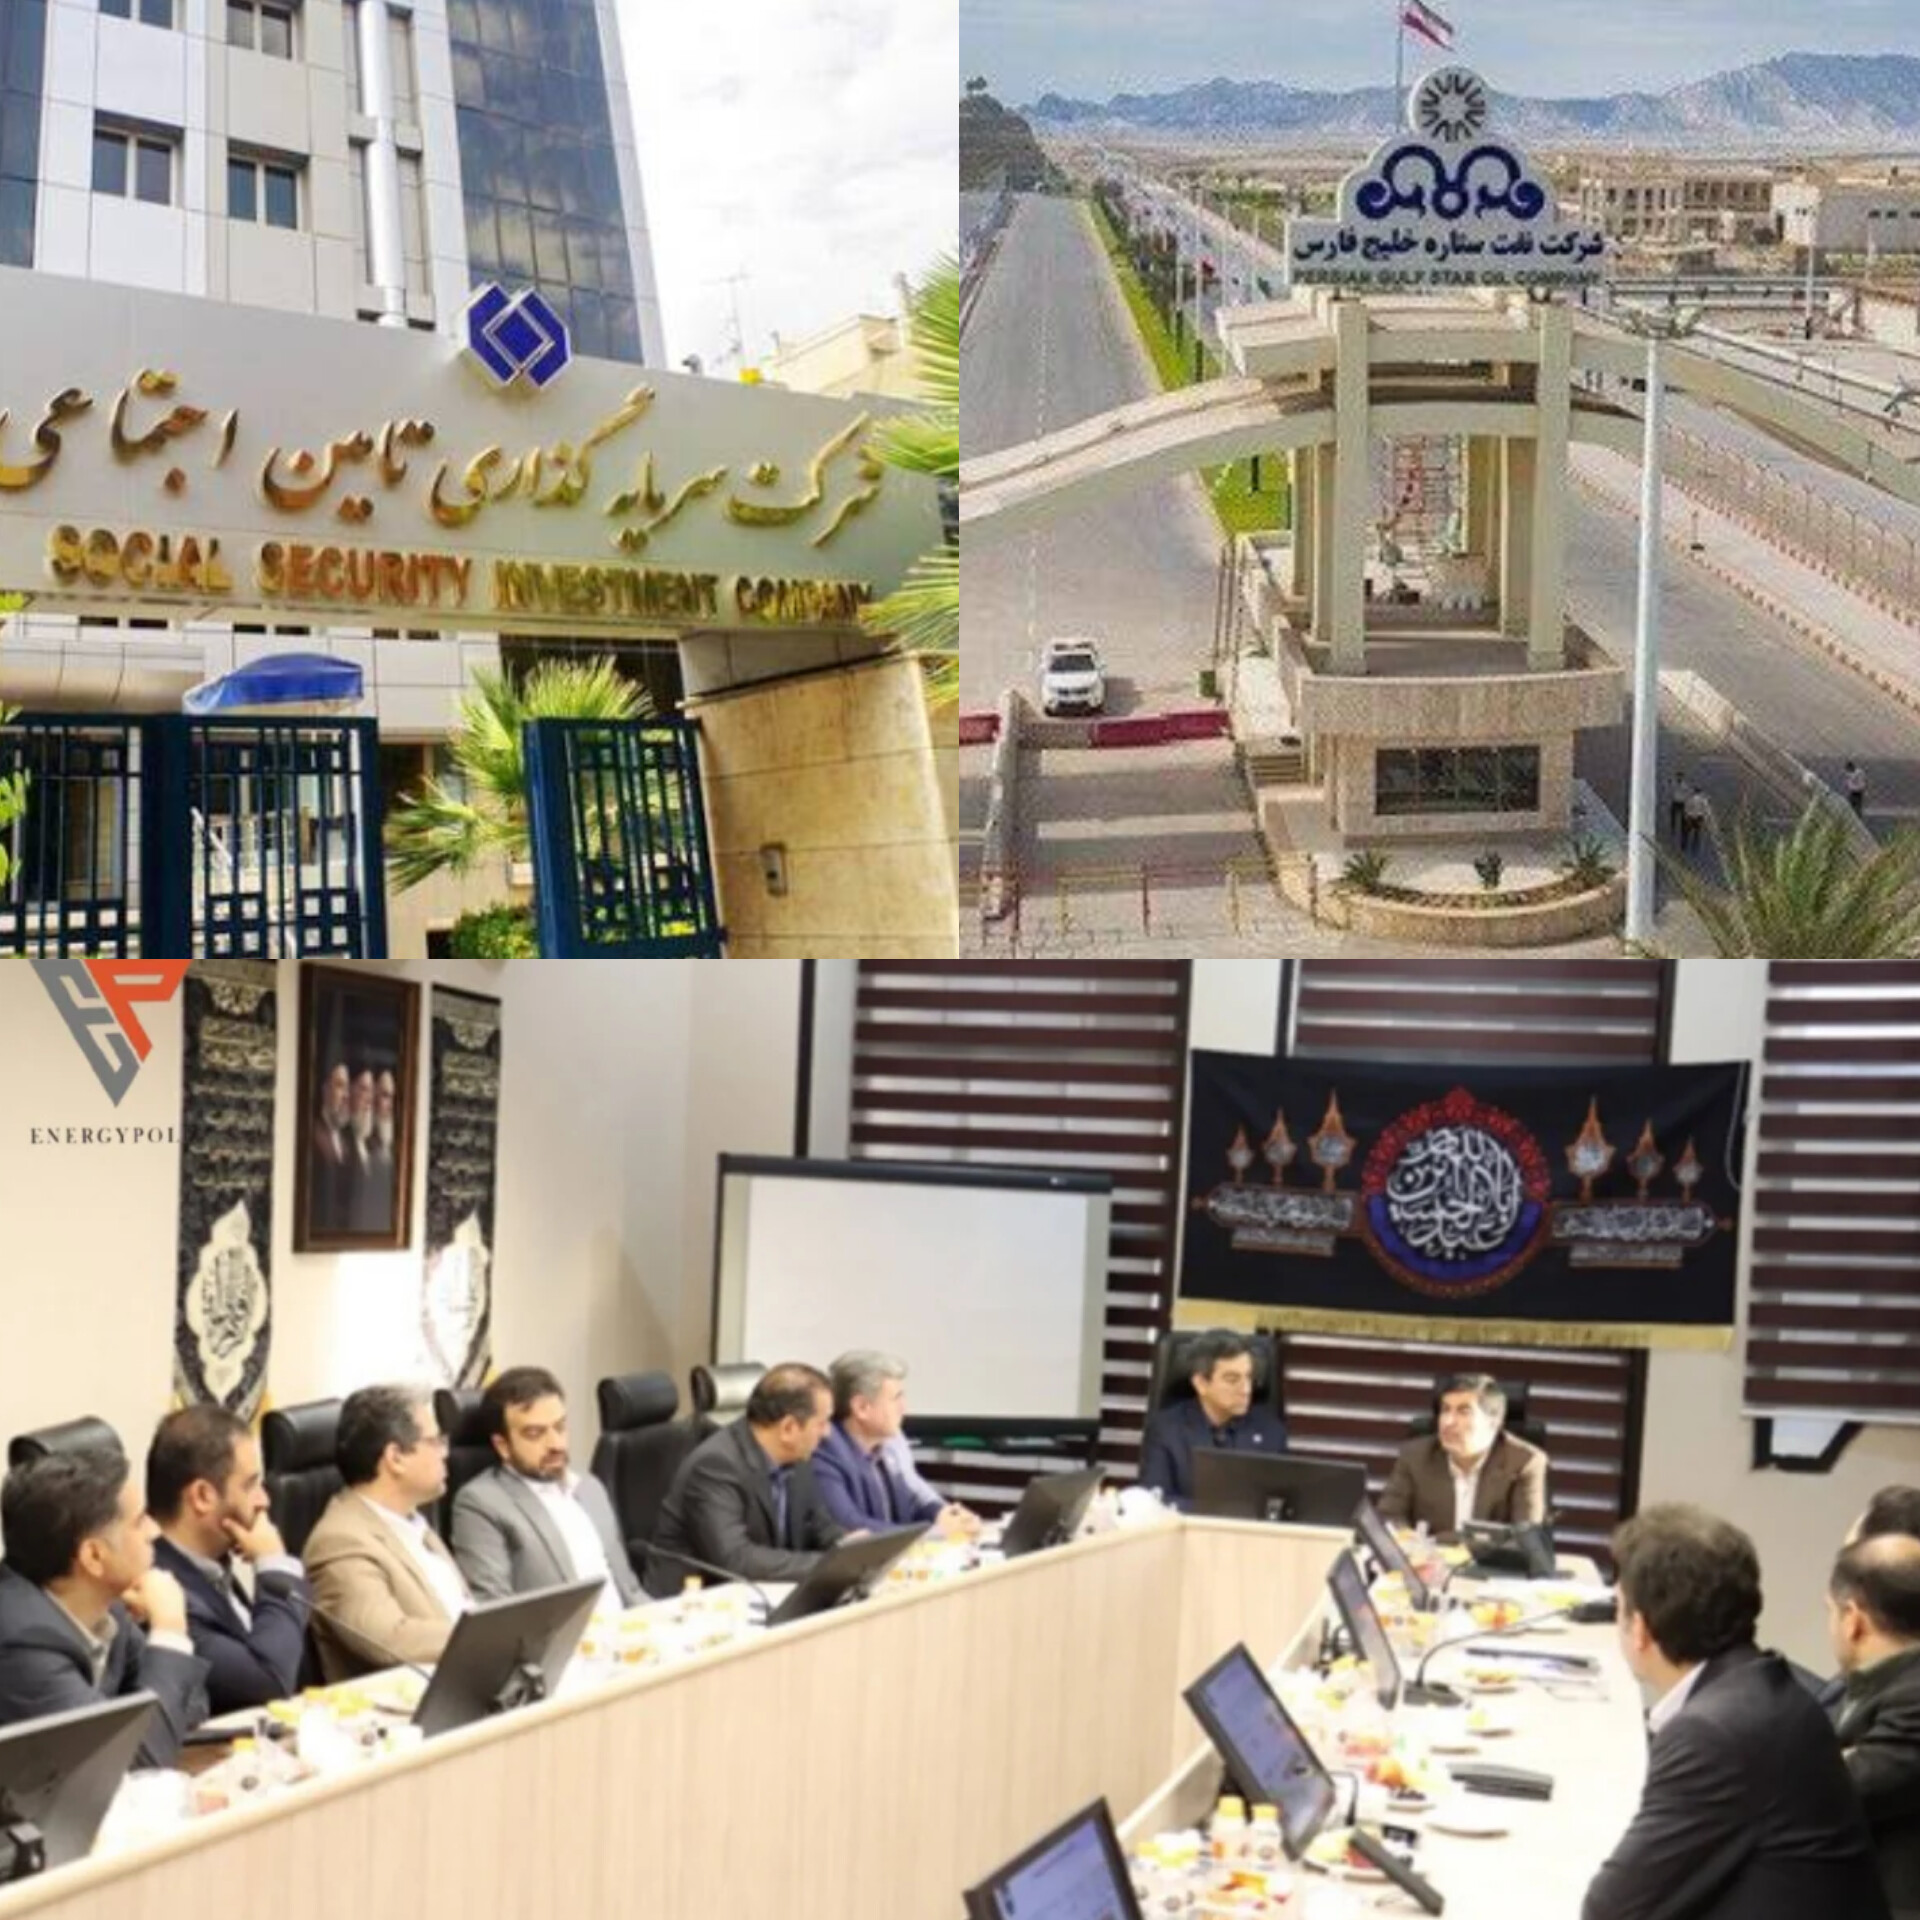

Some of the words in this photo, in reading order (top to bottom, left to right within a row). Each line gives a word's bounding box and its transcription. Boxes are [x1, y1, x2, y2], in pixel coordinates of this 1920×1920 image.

[1293, 225, 1358, 262] فارس
[1361, 226, 1420, 262] خلیج
[1424, 228, 1486, 263] ستاره
[1490, 230, 1534, 255] نفت
[1538, 231, 1604, 264] شرکت
[1428, 269, 1476, 286] STAR
[1514, 270, 1601, 286] COMPANY
[47, 523, 233, 589] SOCIAL
[258, 540, 473, 608] SECURITY
[493, 558, 720, 618] INVESTMENT
